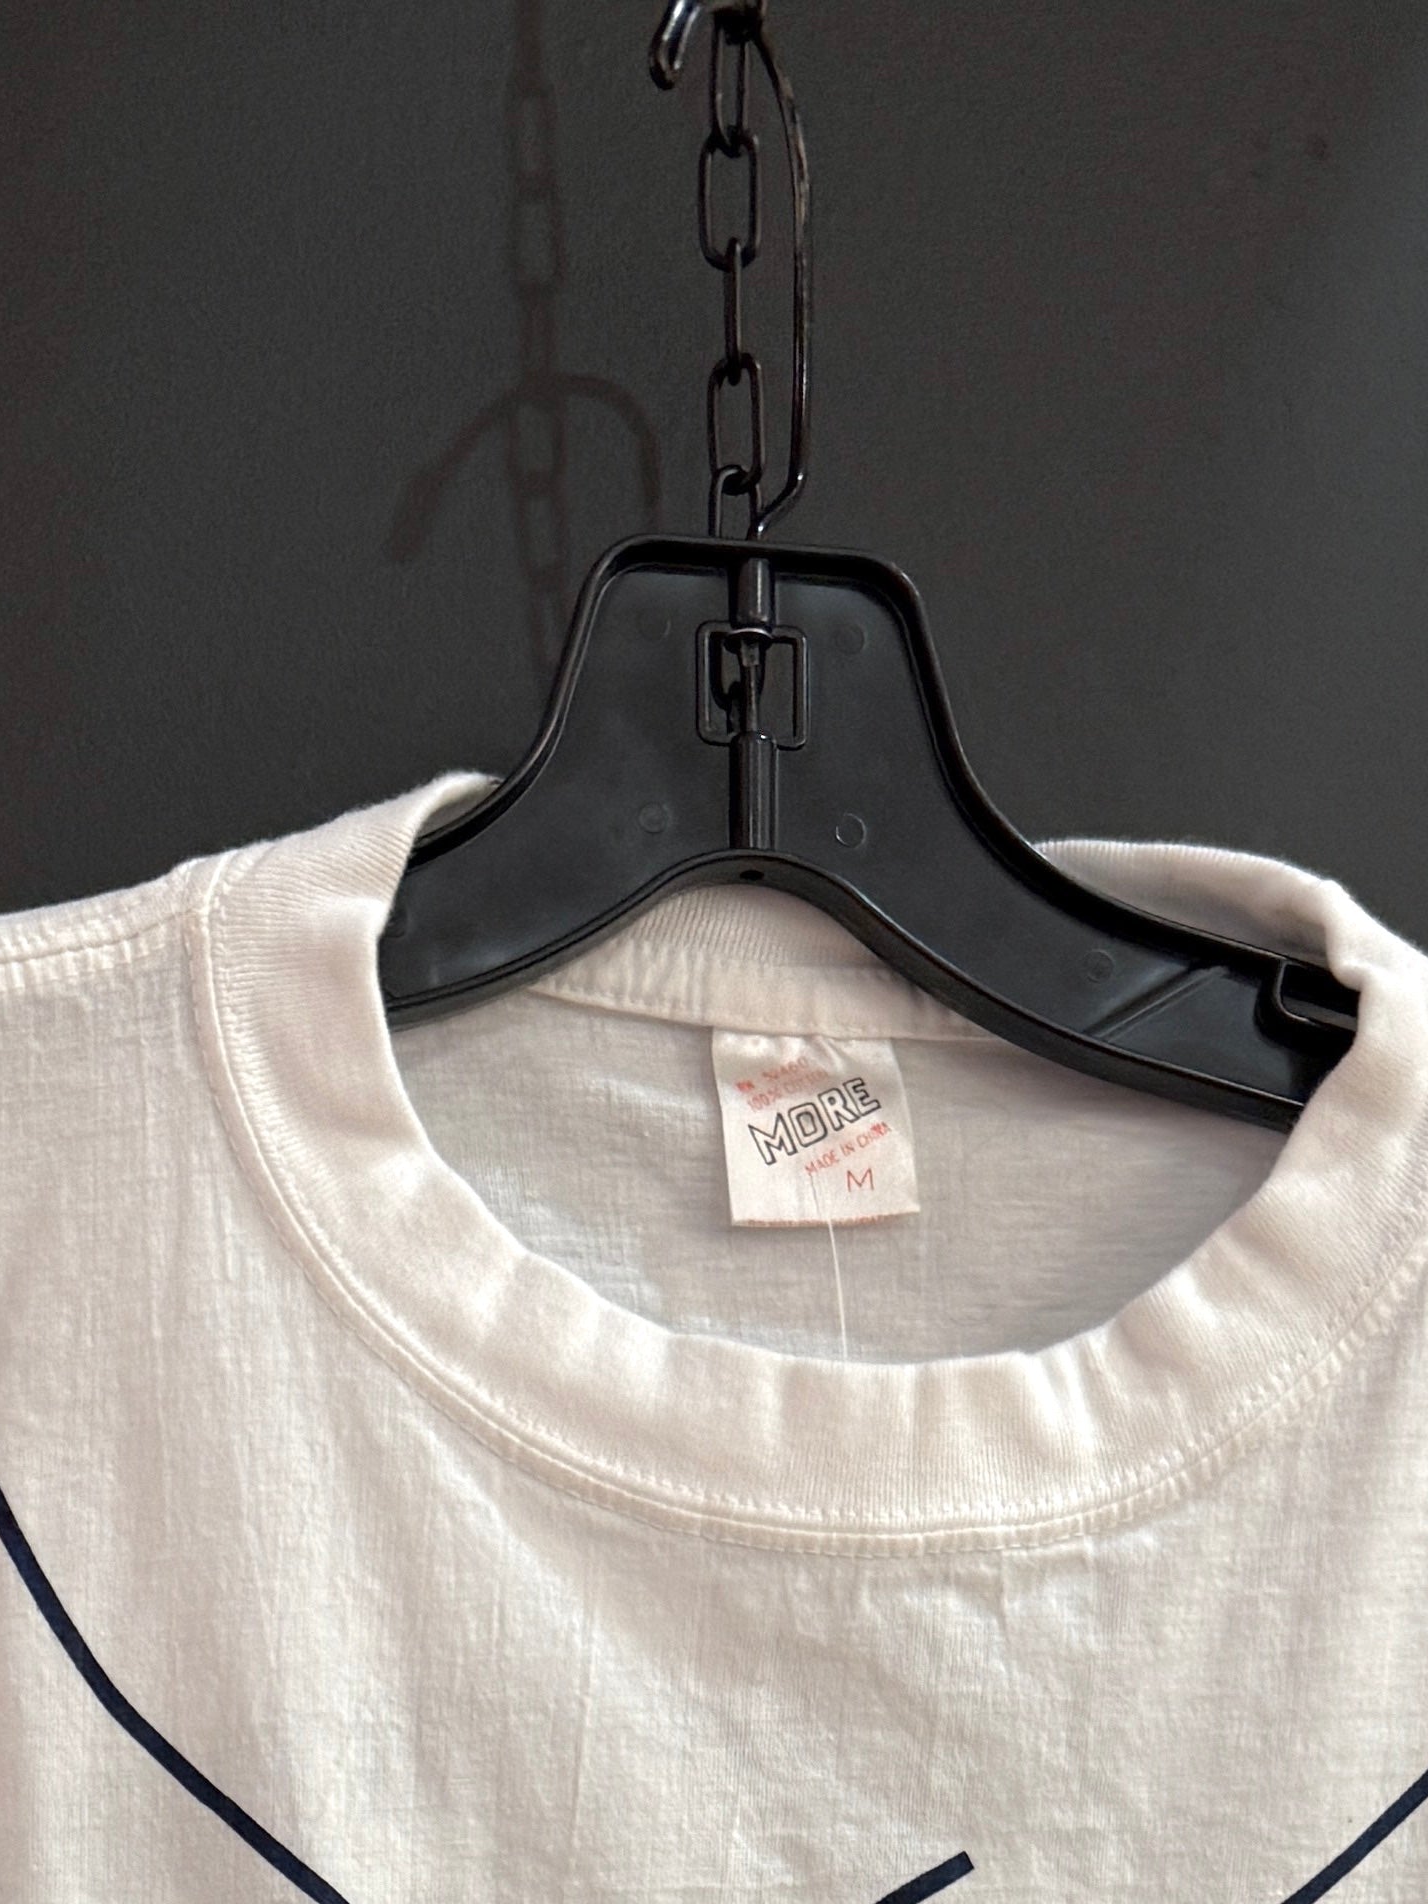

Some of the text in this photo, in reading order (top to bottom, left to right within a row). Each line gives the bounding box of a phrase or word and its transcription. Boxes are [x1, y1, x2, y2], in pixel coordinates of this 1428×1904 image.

[747, 1077, 882, 1166] MORE
[805, 1149, 840, 1176] MADE
[839, 1142, 855, 1157] IN
[846, 1167, 874, 1192] M
